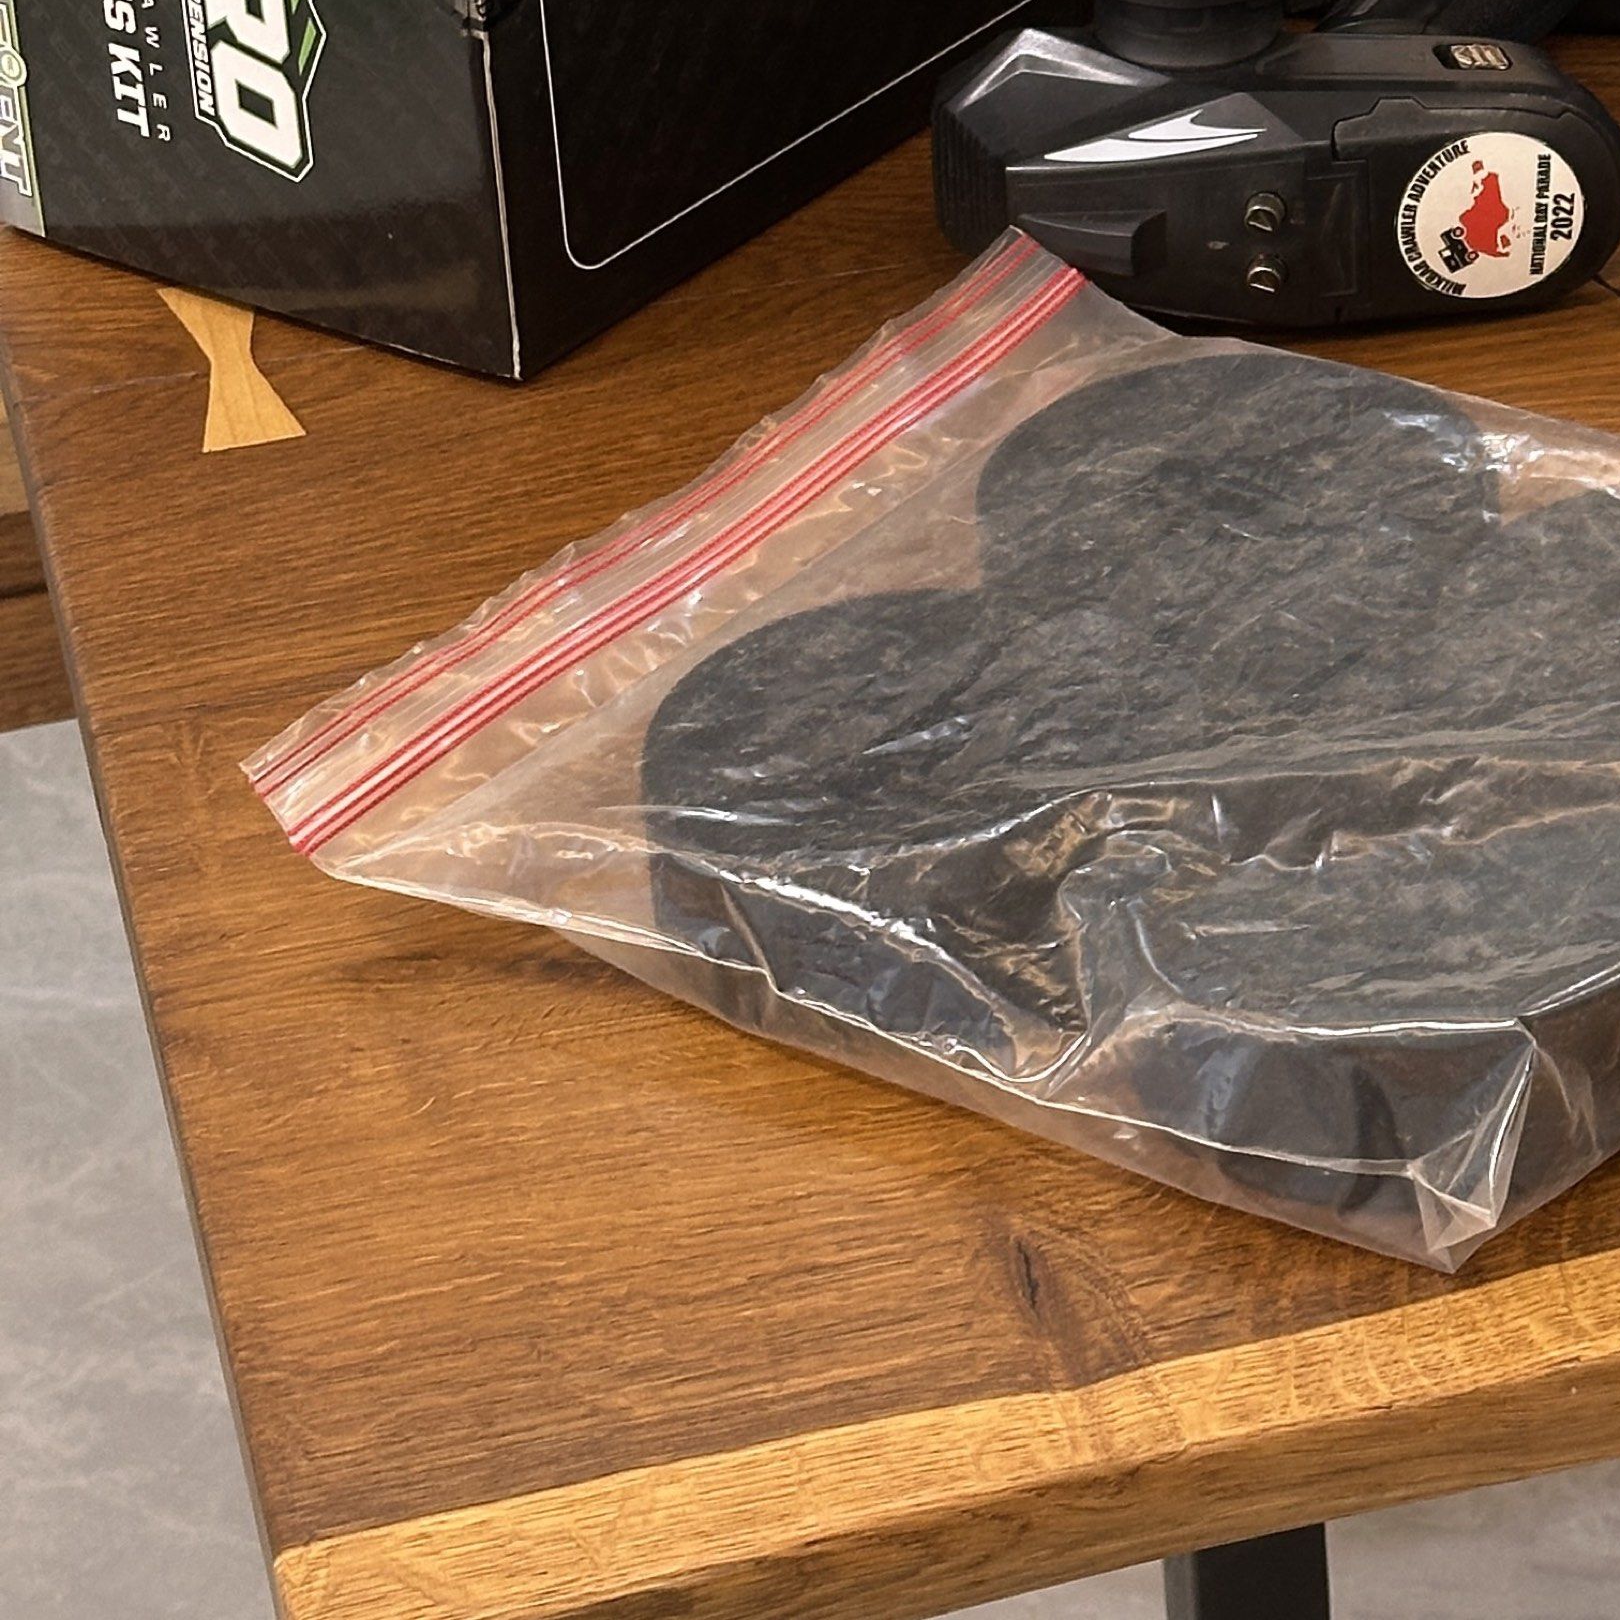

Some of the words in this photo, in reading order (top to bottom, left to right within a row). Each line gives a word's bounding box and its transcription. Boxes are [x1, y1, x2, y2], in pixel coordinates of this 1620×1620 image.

[108, 43, 149, 137] KIT
[1409, 139, 1471, 203] ADVENTURE
[1400, 204, 1422, 263] CRAWLER
[1535, 201, 1549, 222] DAY
[1551, 193, 1575, 241] 2022
[1529, 224, 1548, 275] NATIONAL
